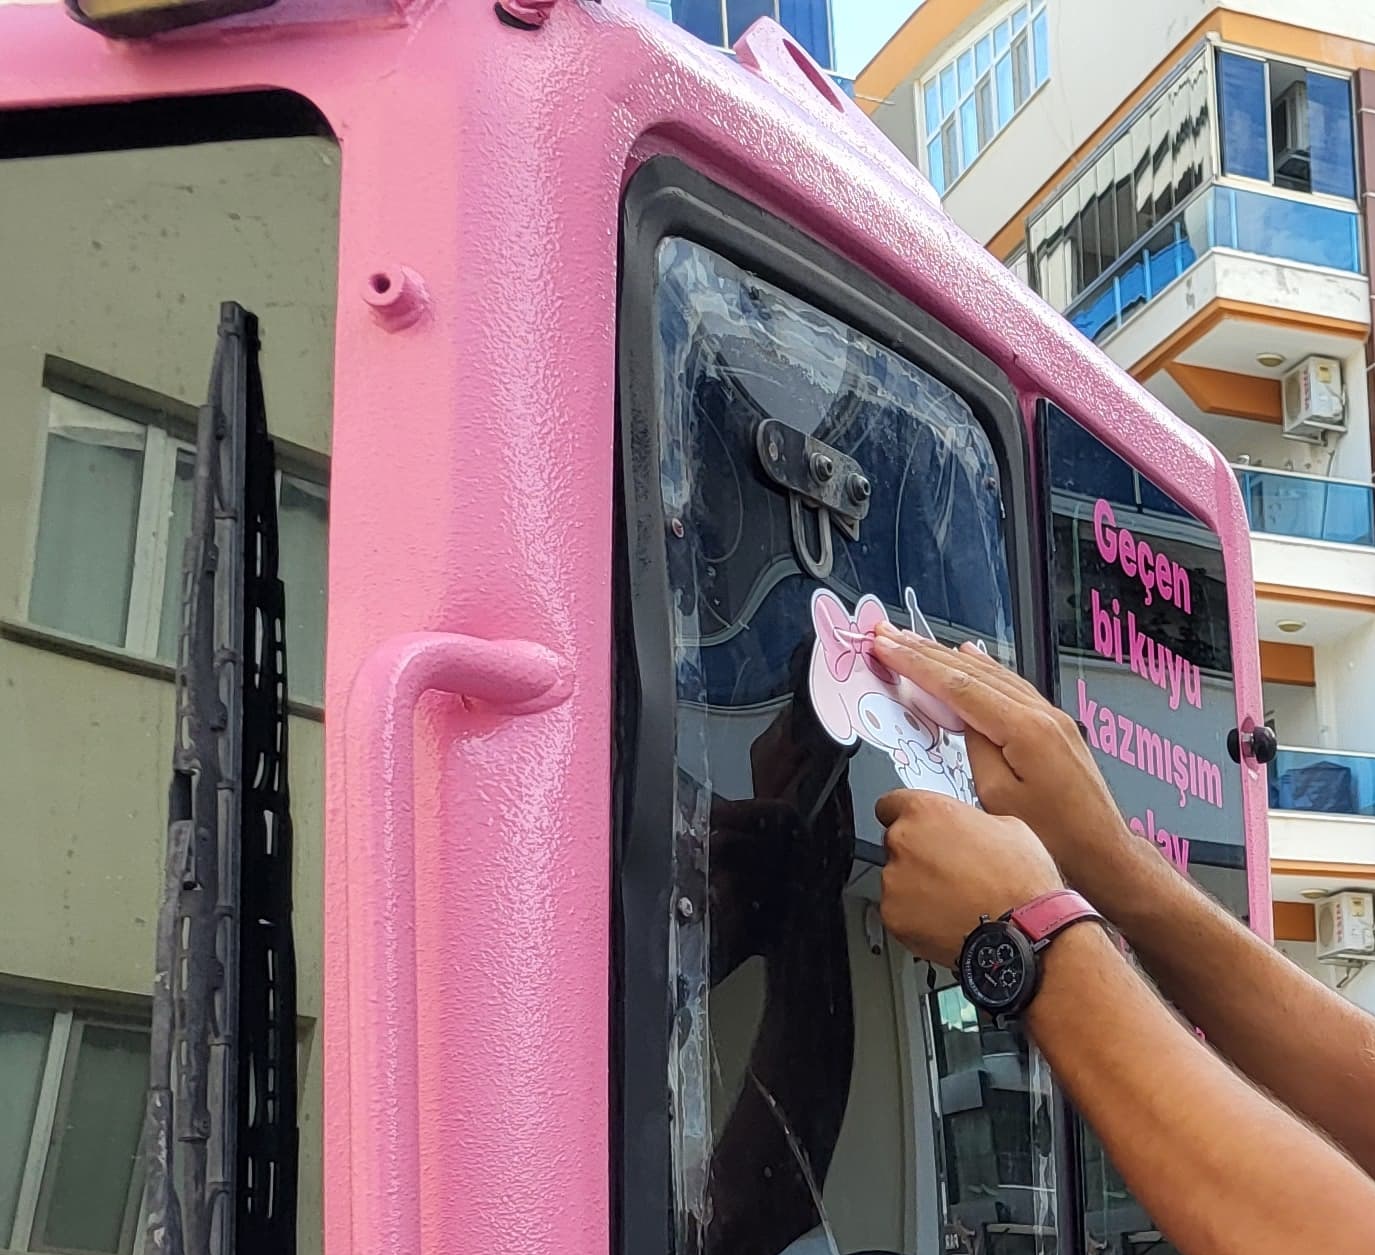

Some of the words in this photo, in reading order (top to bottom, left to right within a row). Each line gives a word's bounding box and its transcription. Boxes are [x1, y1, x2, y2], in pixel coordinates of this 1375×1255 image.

[1093, 498, 1192, 615] Geçen
[1128, 612, 1203, 710] kuyu
[1077, 678, 1223, 809] kazmışım
